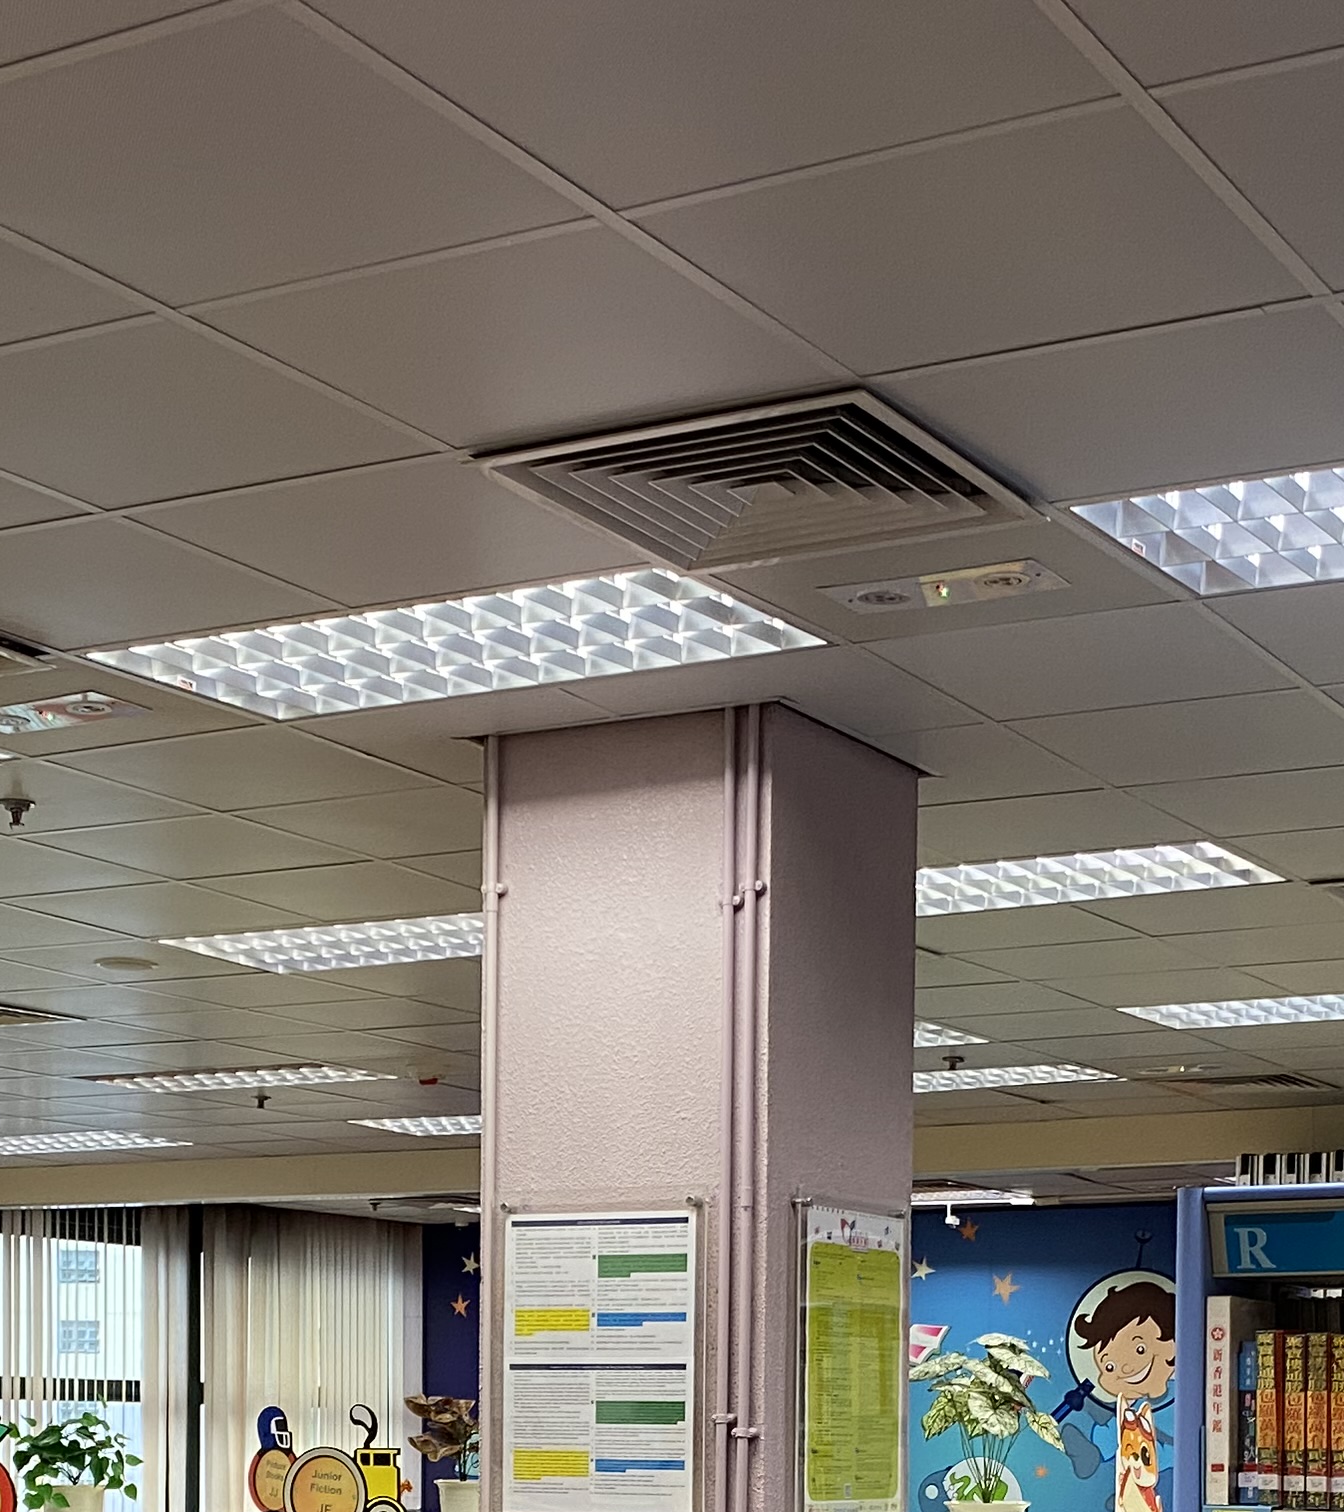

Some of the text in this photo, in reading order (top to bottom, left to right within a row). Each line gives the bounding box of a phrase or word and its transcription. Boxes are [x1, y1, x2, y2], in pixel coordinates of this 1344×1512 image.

[1234, 1227, 1277, 1269] R
[311, 1469, 342, 1482] Junior
[310, 1483, 342, 1496] Fiction
